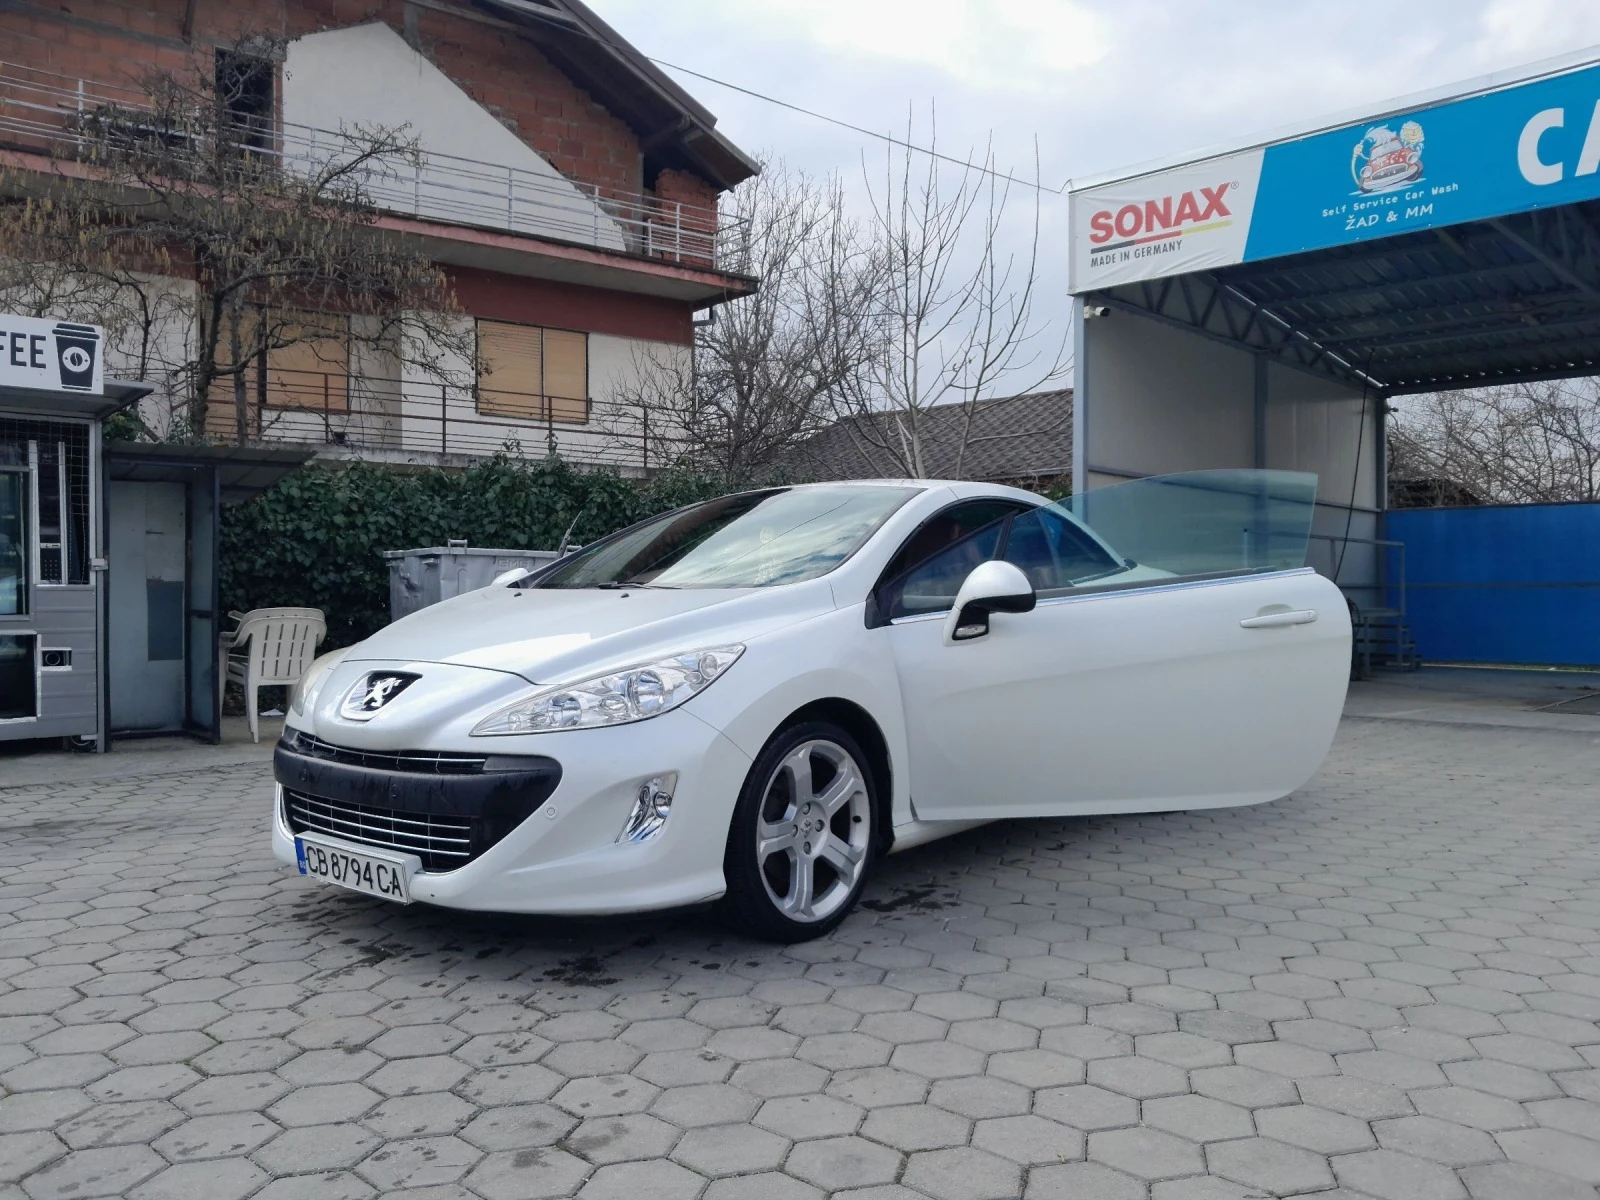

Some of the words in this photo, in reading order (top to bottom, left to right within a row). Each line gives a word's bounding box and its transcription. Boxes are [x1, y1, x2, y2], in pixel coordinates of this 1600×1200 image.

[1322, 204, 1347, 217] Self
[1353, 196, 1398, 211] Service
[1405, 190, 1425, 201] Car
[1431, 182, 1459, 196] Wash
[1345, 214, 1379, 230] ŽAD
[1386, 210, 1398, 222] &
[1405, 203, 1433, 219] MM
[1090, 253, 1117, 267] MADE
[1120, 249, 1130, 260] IN
[1134, 239, 1183, 258] GERMANY
